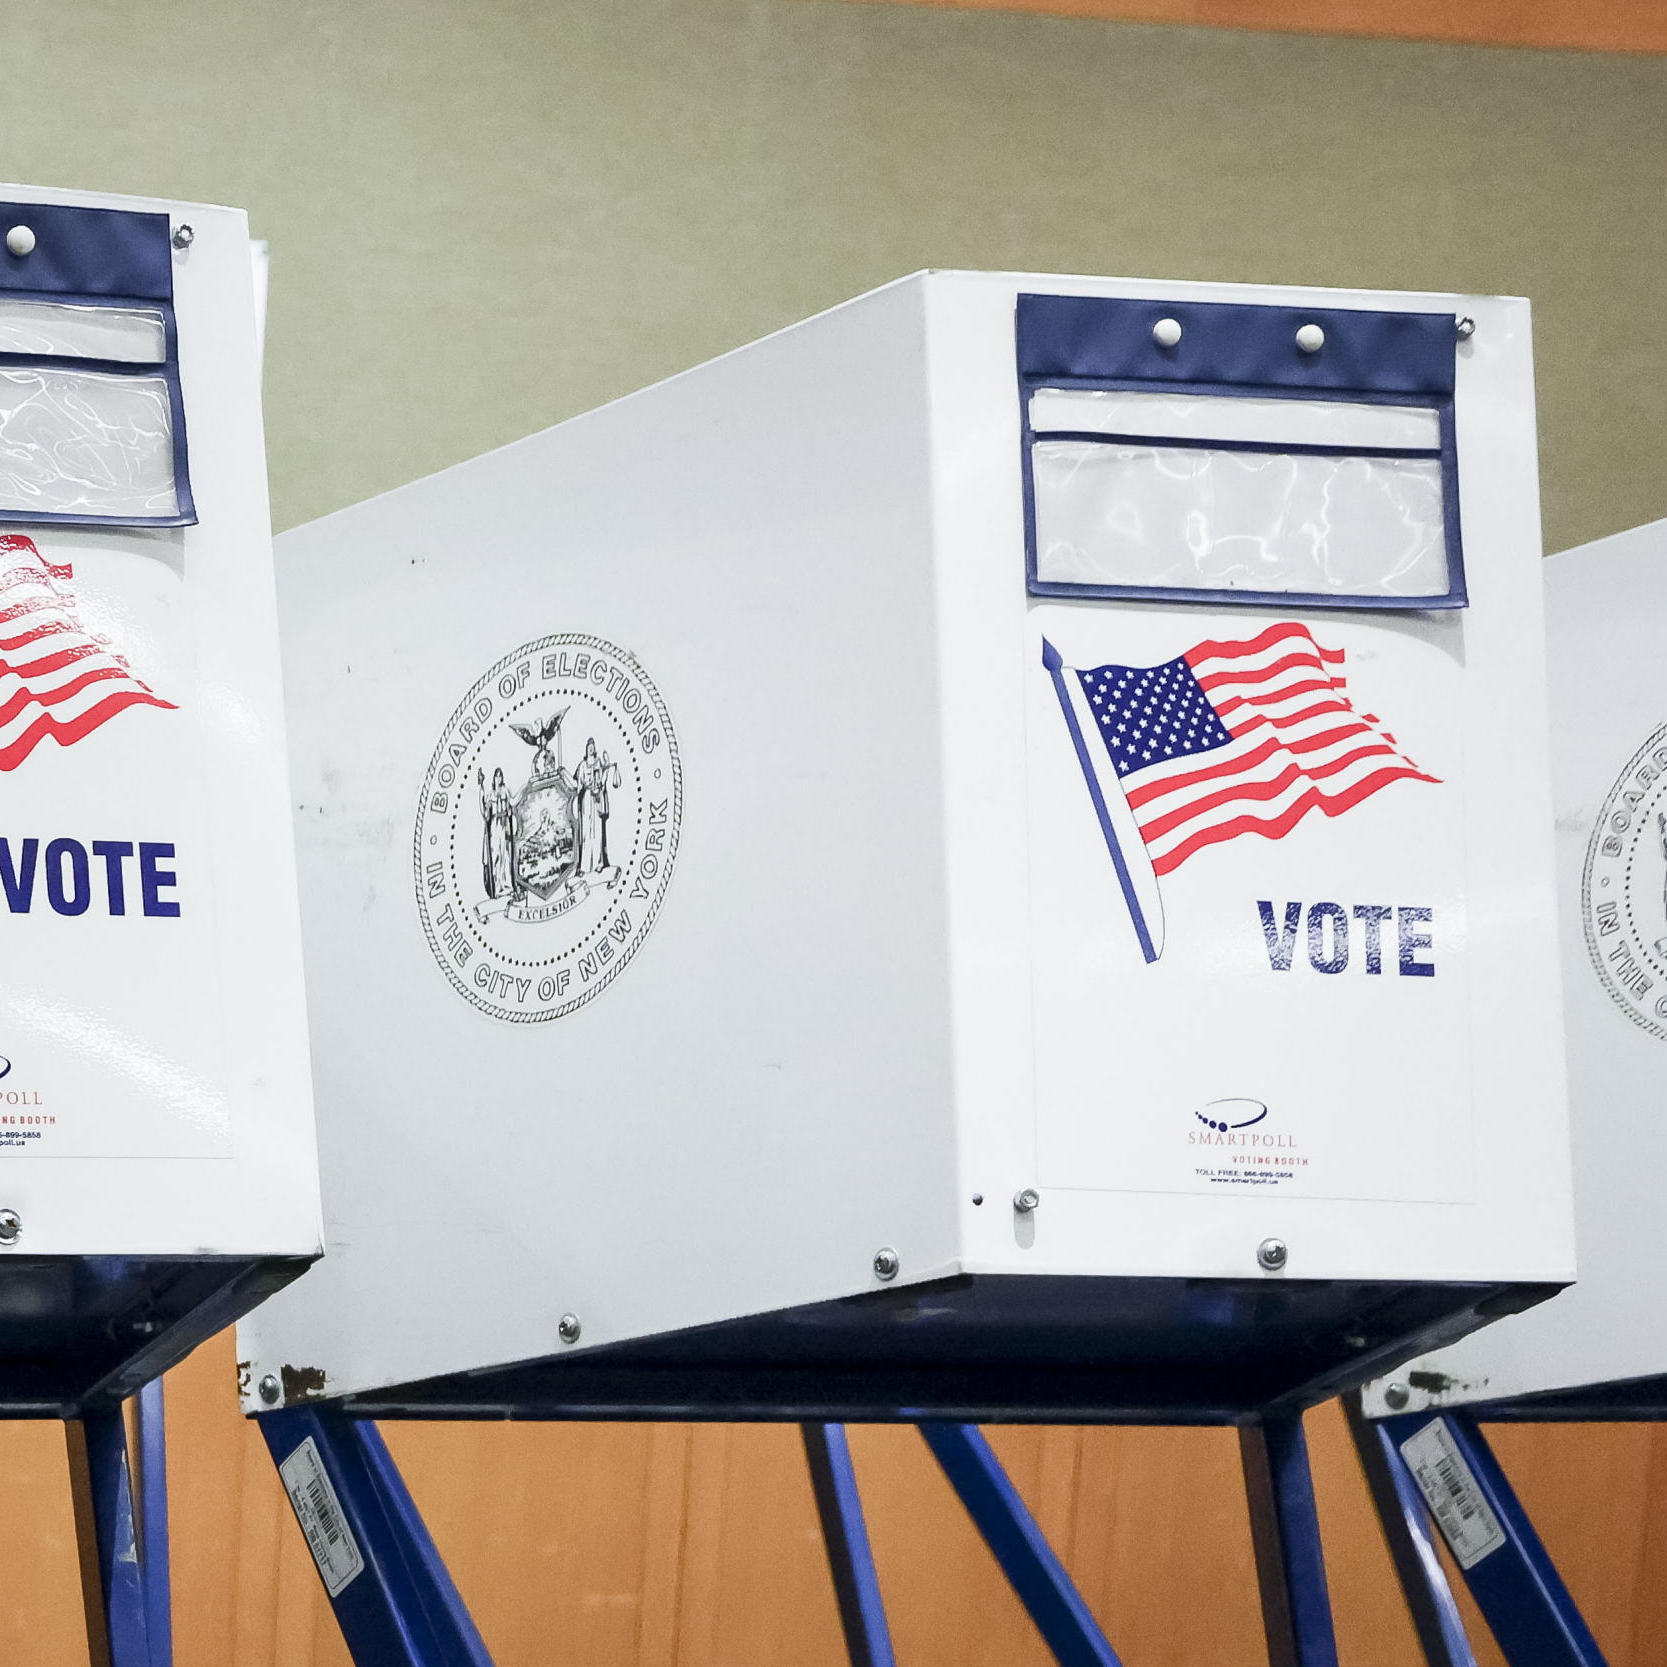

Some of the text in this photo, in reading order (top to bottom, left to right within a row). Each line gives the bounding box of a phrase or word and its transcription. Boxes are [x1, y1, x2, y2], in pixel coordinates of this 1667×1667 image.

[430, 652, 661, 815] BOARD OF ELECTIONS
[1600, 745, 1667, 859] BOARD
[425, 797, 669, 1004] IN THE CITY OF NEW YORK
[518, 895, 577, 920] EXCELSIOR
[1256, 900, 1435, 957] VOTE
[1596, 900, 1655, 1001] IN THE
[20, 1116, 56, 1125] BOOTH
[1188, 1131, 1297, 1148] SMARTPOLL
[1232, 1156, 1309, 1166] VOTING BOOTH
